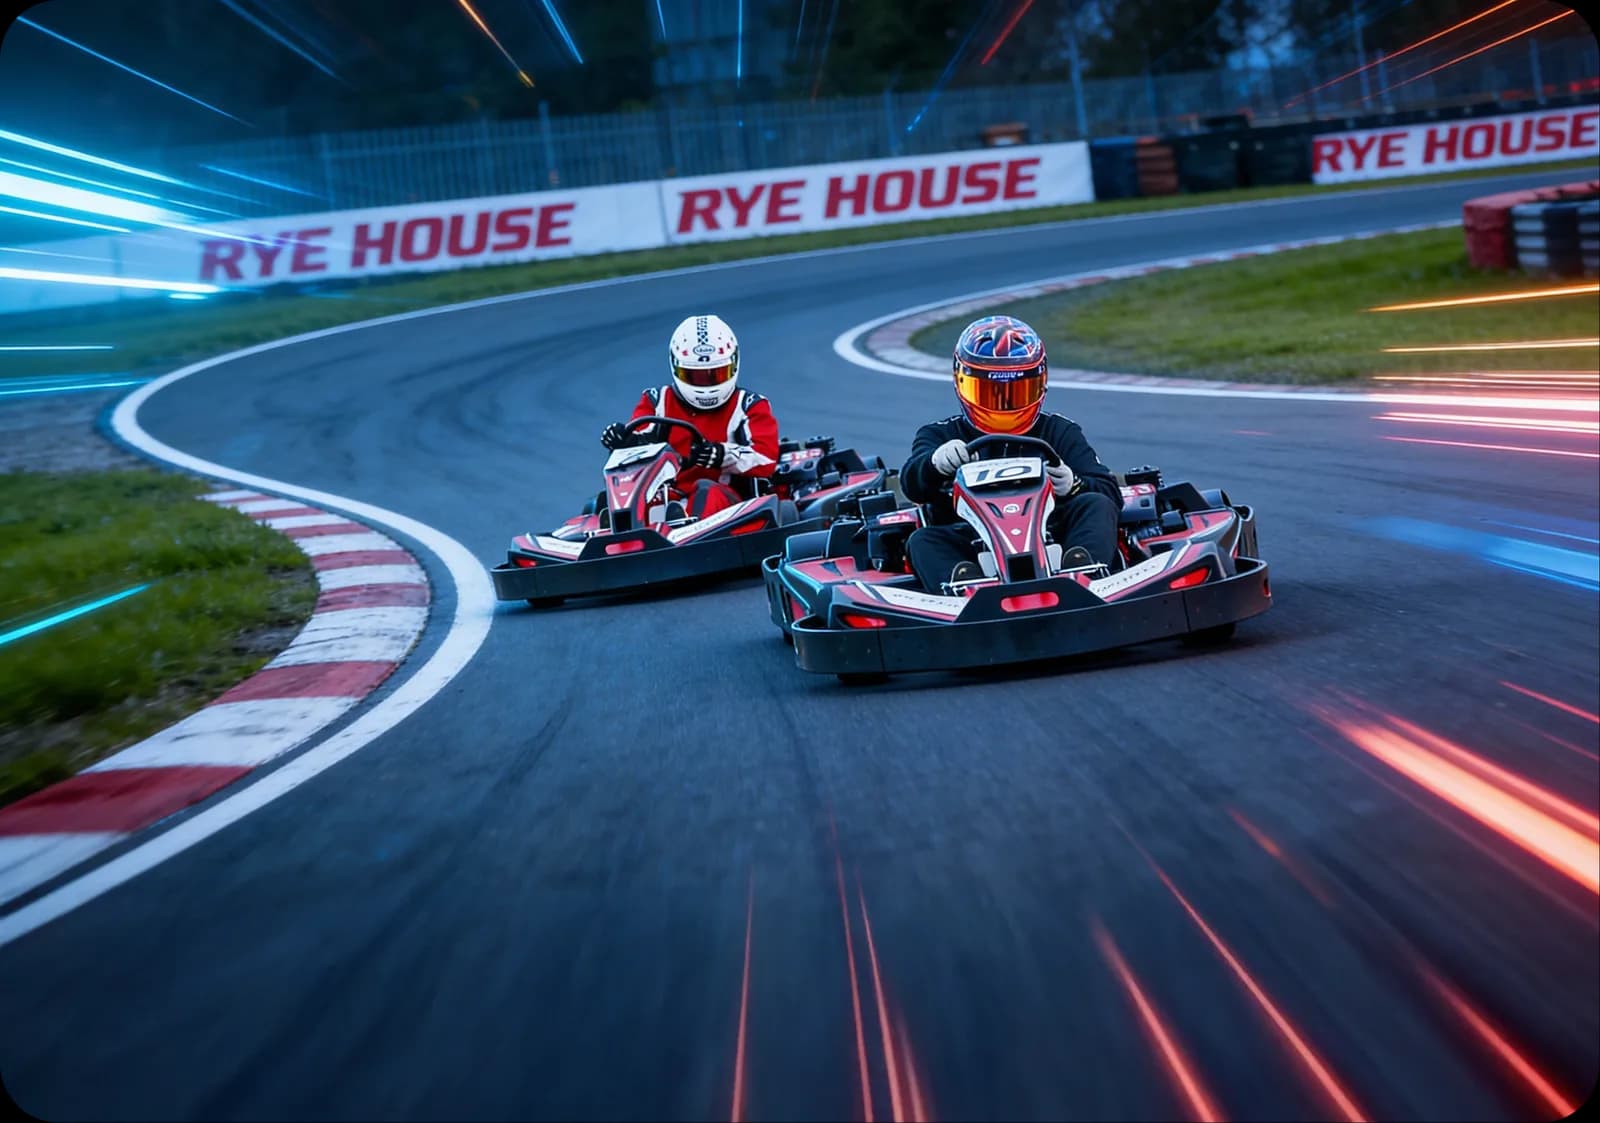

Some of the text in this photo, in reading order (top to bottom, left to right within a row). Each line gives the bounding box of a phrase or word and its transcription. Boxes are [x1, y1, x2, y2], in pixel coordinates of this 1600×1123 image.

[1312, 111, 1600, 173] RYE HOUSE
[677, 157, 1041, 234] RYE HOUSE
[200, 203, 575, 281] RYE HOUSE
[977, 466, 1032, 481] 10
